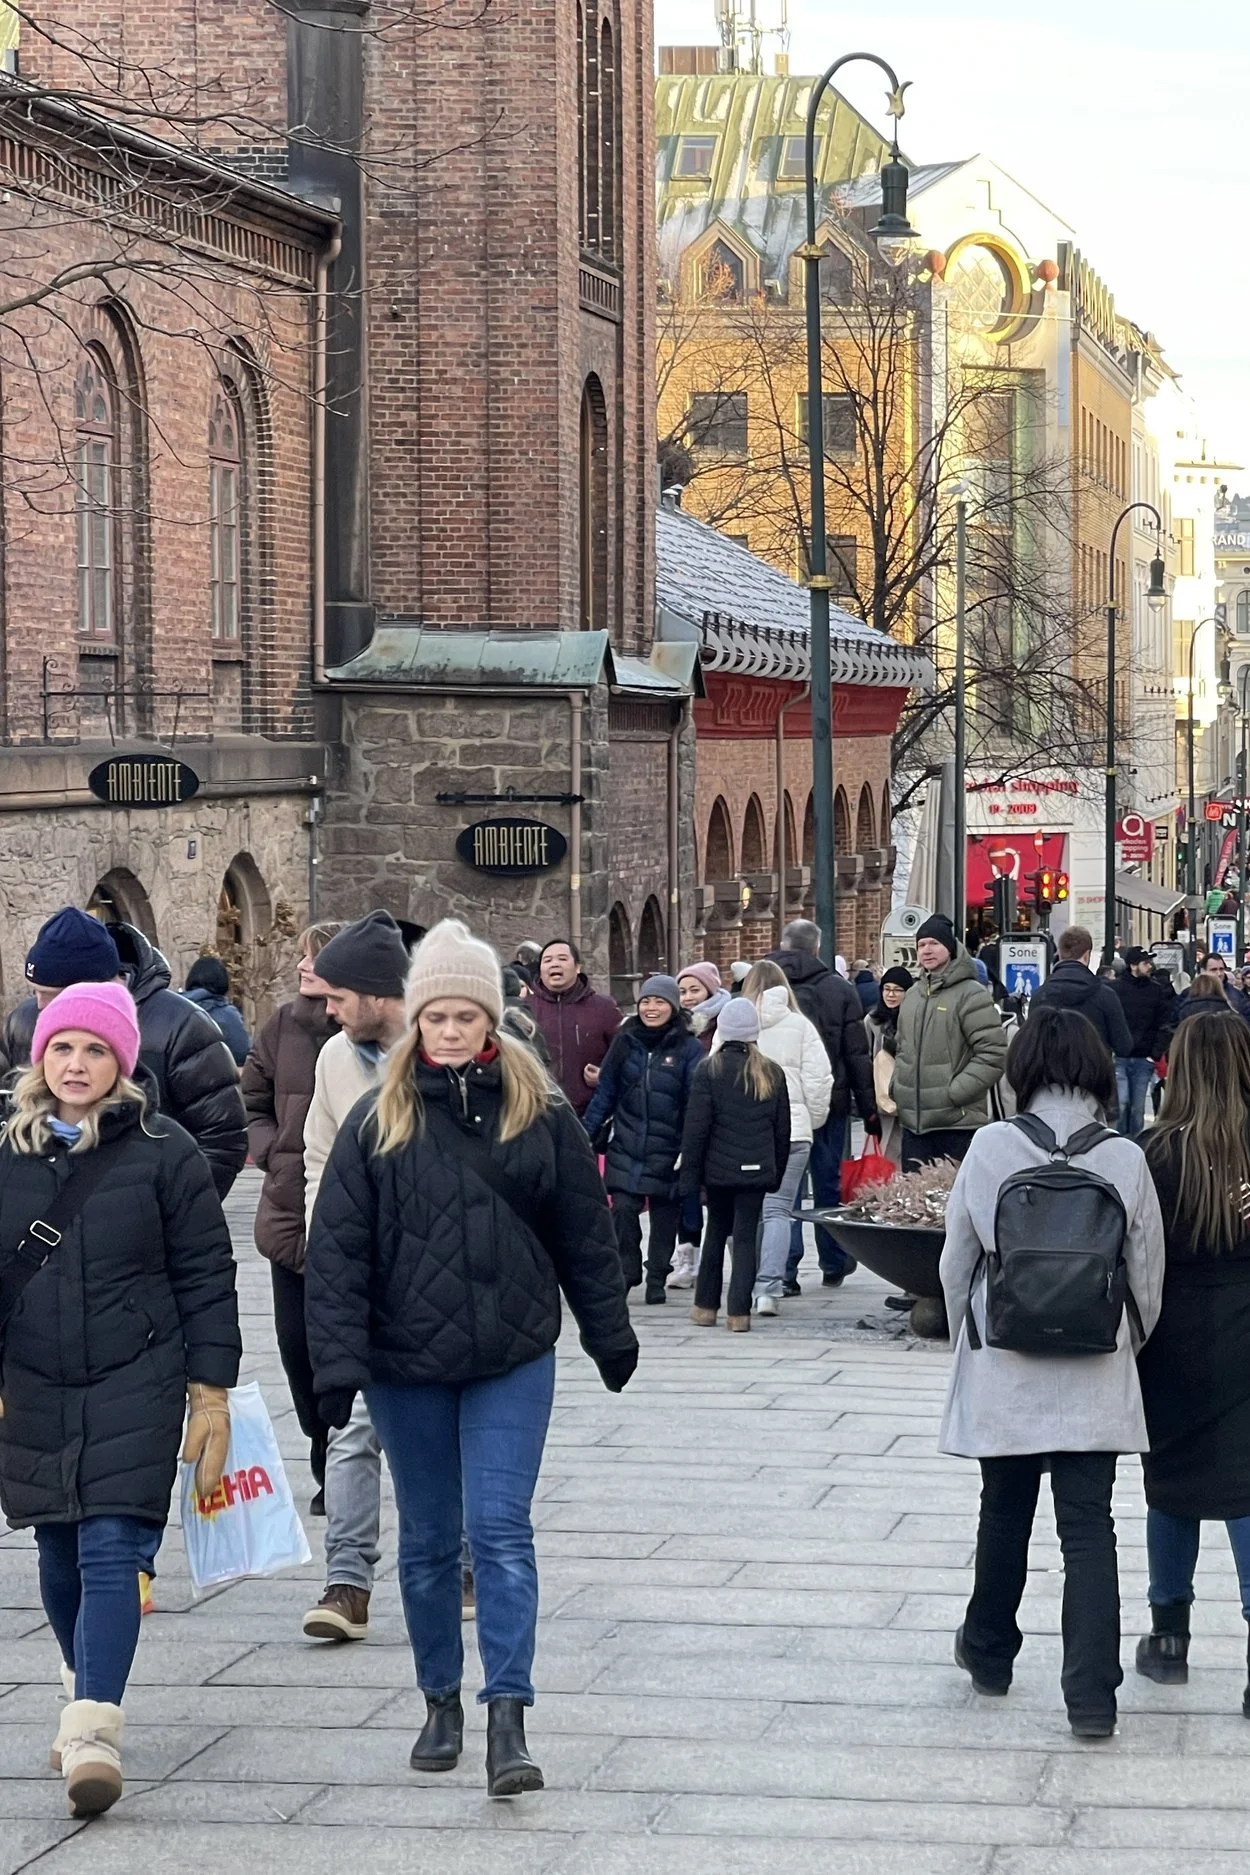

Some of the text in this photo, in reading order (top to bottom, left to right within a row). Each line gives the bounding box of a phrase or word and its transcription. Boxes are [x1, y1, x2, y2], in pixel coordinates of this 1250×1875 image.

[1211, 534, 1245, 546] RAND
[107, 763, 182, 801] AMBIENTE
[1223, 813, 1236, 827] N
[473, 826, 549, 865] AMBIENTE
[1009, 946, 1038, 957] Sone
